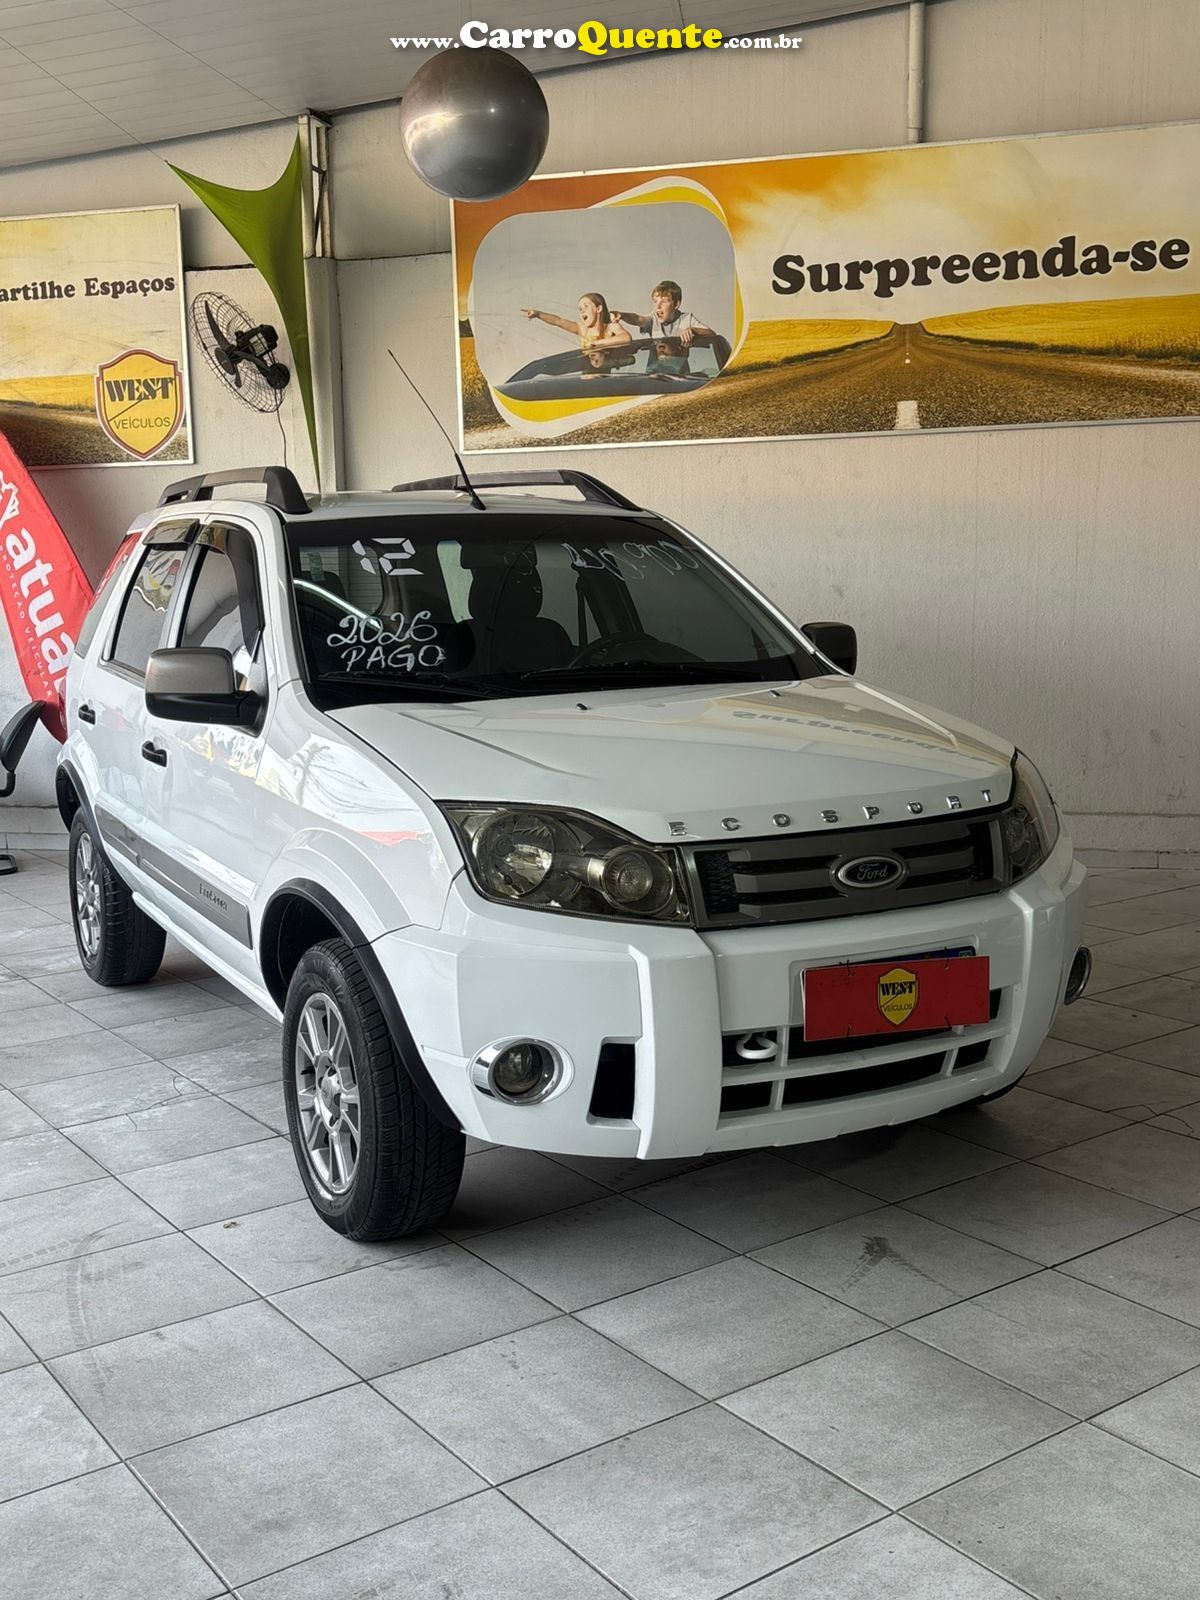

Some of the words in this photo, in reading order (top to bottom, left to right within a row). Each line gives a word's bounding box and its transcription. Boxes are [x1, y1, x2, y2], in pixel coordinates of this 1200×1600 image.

[772, 236, 1191, 298] Surpreenda-se
[0, 280, 76, 302] artilhe
[84, 277, 175, 297] Espaços
[105, 377, 174, 402] WEST
[114, 416, 171, 430] VEÍCULOS
[352, 537, 424, 575] 12
[327, 610, 438, 647] 2026
[25, 626, 53, 697] VEICULAR
[340, 644, 446, 672] PAGO
[668, 788, 992, 837] ECOSPORT
[857, 863, 888, 880] Ford
[880, 981, 916, 996] WEST
